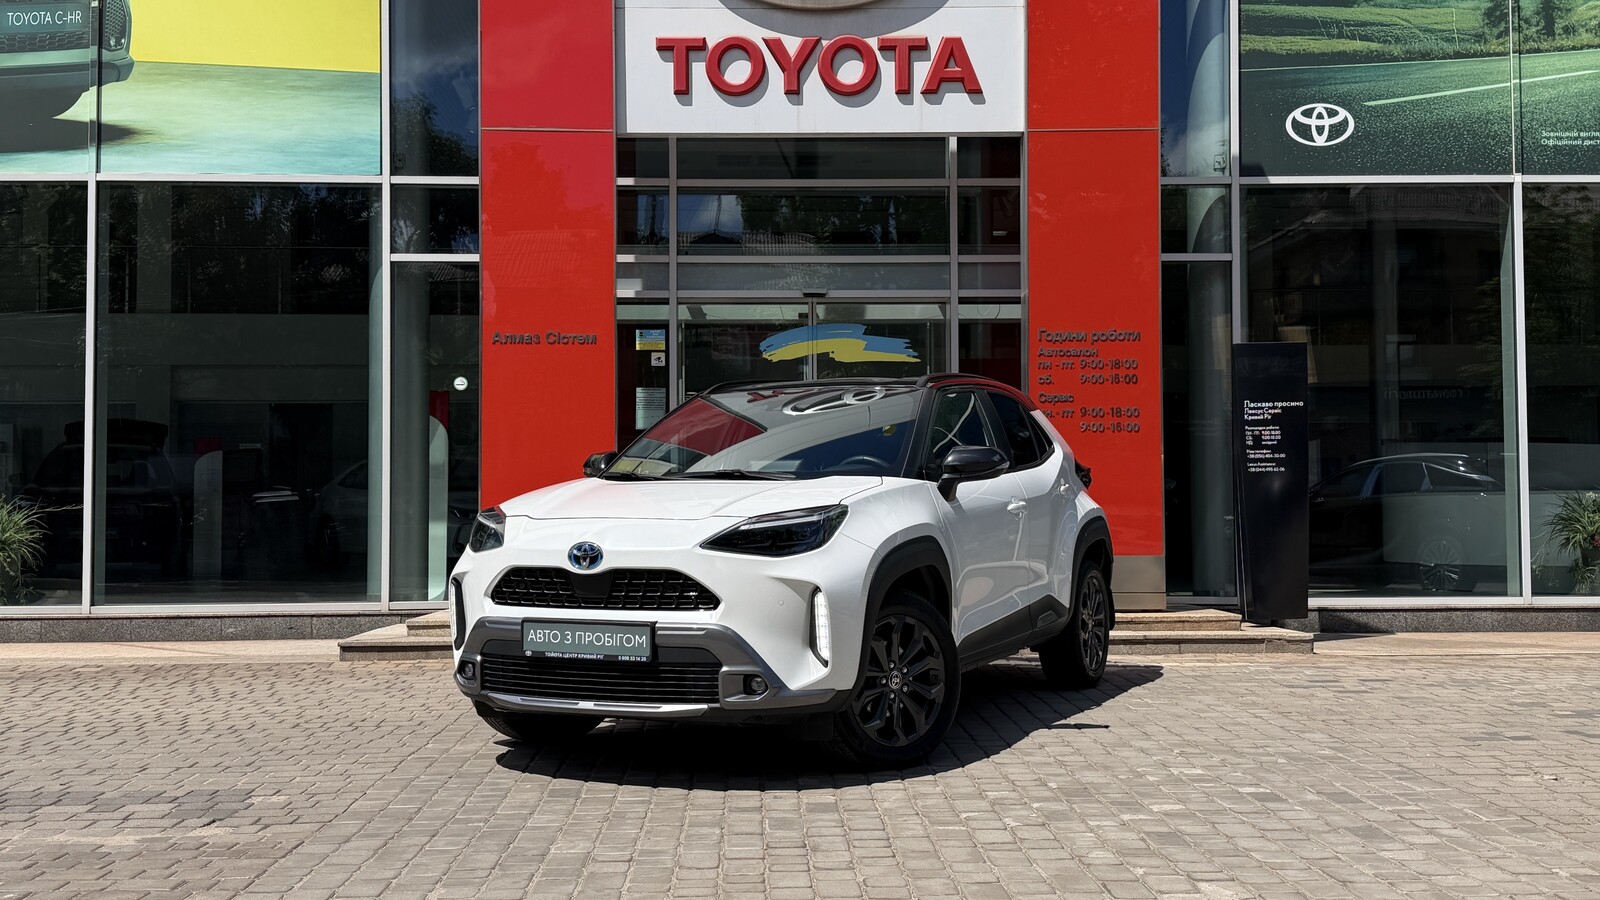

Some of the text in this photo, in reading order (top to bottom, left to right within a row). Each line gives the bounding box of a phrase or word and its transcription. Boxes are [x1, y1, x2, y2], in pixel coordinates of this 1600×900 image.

[7, 11, 82, 26] TOYOTA C-HR
[655, 34, 983, 97] TOYOTA
[1541, 138, 1582, 146] Офіційний
[492, 330, 598, 345] Алмаз Сістем
[1038, 329, 1141, 345] Години роботи
[1038, 346, 1099, 358] Автосалон
[1038, 393, 1074, 406] Сервіс
[1244, 400, 1273, 408] Ласкаво
[527, 629, 646, 648] АВТО З ПРОБІГОМ
